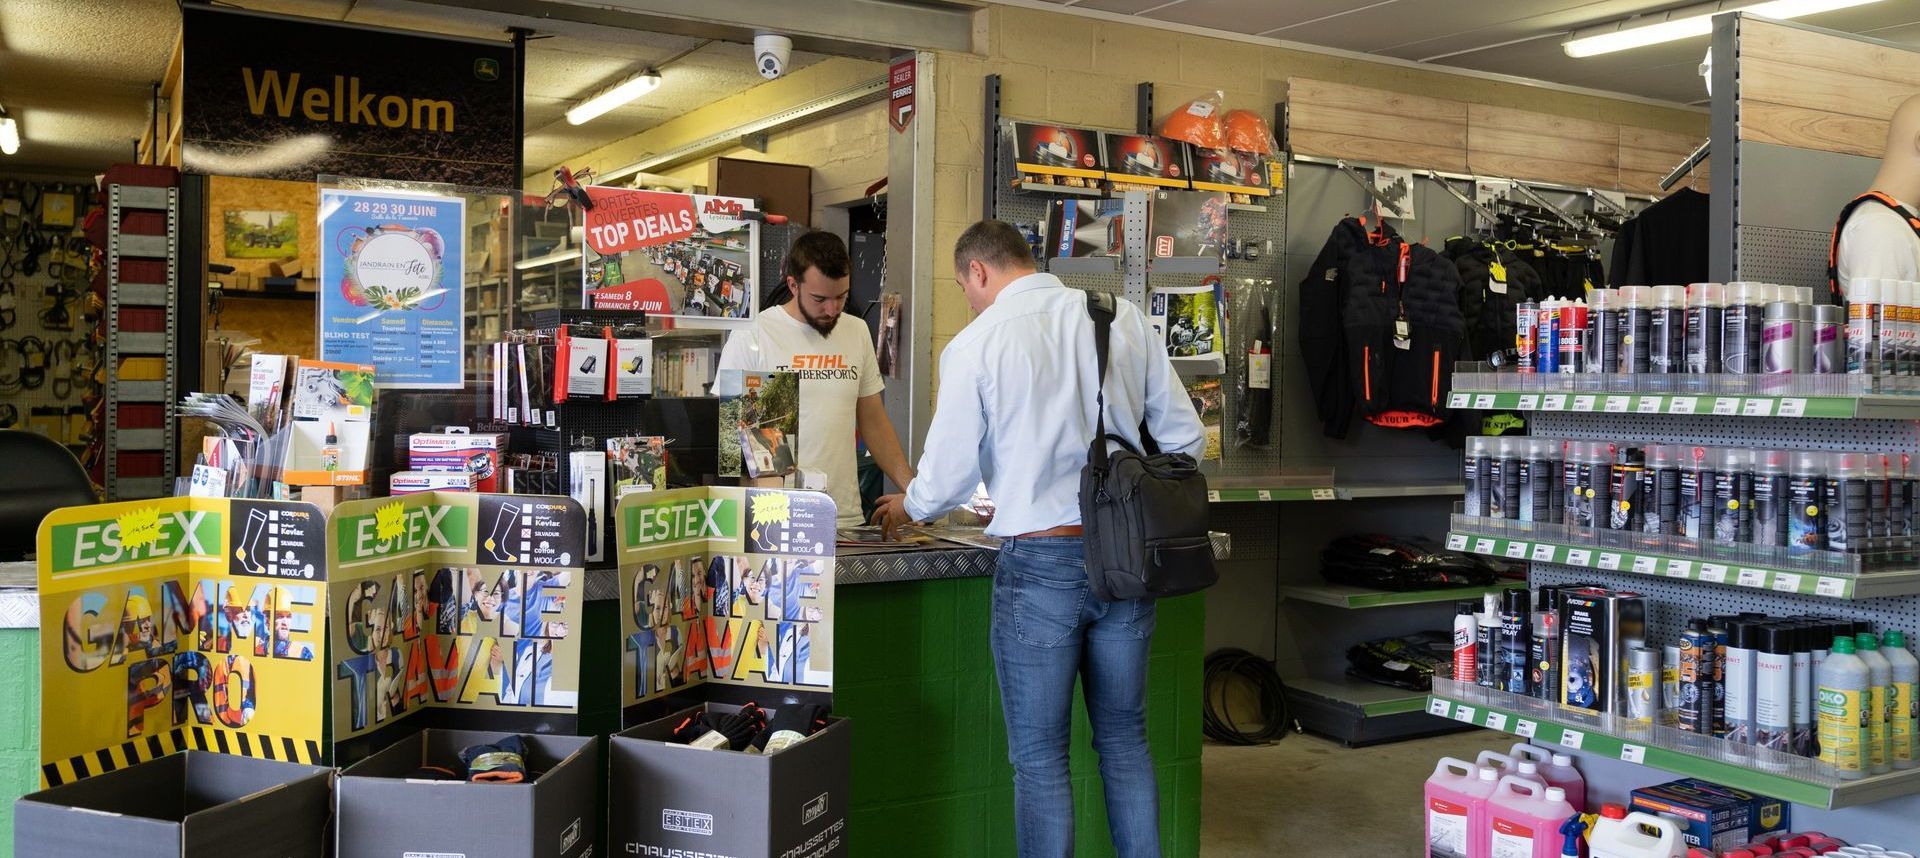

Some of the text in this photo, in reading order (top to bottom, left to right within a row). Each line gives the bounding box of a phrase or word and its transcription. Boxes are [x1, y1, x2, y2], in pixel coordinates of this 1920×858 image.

[893, 70, 912, 85] DEALER
[241, 67, 455, 132] Welkom
[892, 85, 913, 100] FERRIS
[354, 201, 370, 213] 28
[372, 203, 388, 214] 29
[390, 204, 406, 215] 30
[407, 206, 433, 216] JUIN
[592, 192, 640, 211] PORTES
[594, 203, 660, 225] OUVERTES
[591, 209, 693, 249] TOP DEALS
[360, 261, 395, 269] JANDRAIN
[625, 291, 632, 300] 8
[600, 302, 631, 310] DIMANCHE
[633, 301, 639, 310] 9
[640, 302, 662, 311] JUIN
[324, 332, 349, 340] BLIND
[351, 332, 371, 340] TEST
[792, 354, 848, 369] STIHL
[336, 474, 361, 482] STIHL
[535, 519, 560, 527] Kevlar
[639, 499, 724, 544] ESTEX
[281, 527, 304, 536] Kevlar
[534, 556, 553, 564] WOOL
[281, 568, 298, 577] WOOL
[633, 555, 824, 631] GAMME
[346, 568, 572, 655] GAMME
[63, 578, 317, 673] GAMME
[626, 616, 832, 699] TRAVAIL
[337, 634, 578, 732] TRAVAIL
[127, 651, 257, 739] PRO
[1575, 695, 1584, 703] 5L
[665, 814, 711, 831] ESTEX
[1716, 810, 1730, 821] LITER
